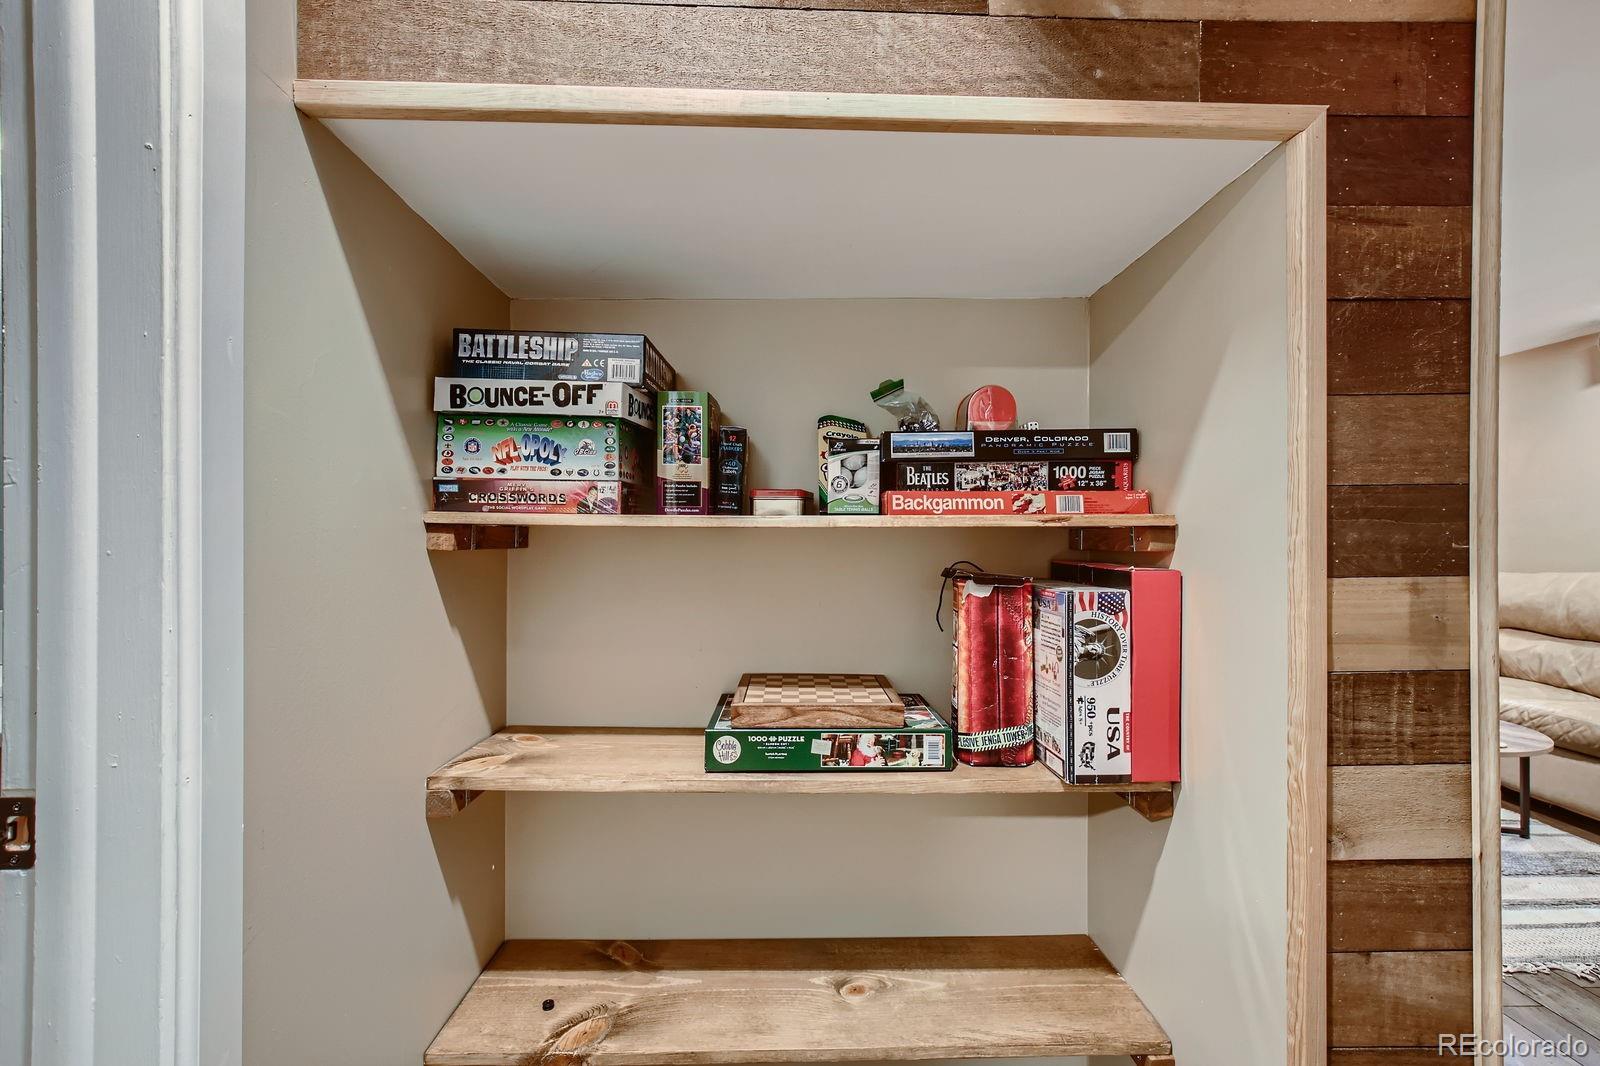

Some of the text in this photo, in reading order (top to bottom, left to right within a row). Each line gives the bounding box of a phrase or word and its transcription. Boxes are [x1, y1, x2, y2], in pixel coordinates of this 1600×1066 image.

[458, 334, 578, 361] BATTLESHIP
[450, 382, 603, 408] BOUNCE-OFF
[906, 466, 949, 488] BEATLES
[1053, 466, 1086, 479] 1000
[468, 492, 566, 504] CROSSWORDS
[892, 495, 1004, 514] Backgammon
[1091, 611, 1128, 687] HISTORY OVER TIME PUZZLE
[1087, 697, 1096, 719] 950
[981, 733, 1002, 746] JENGA
[1106, 707, 1120, 760] USA
